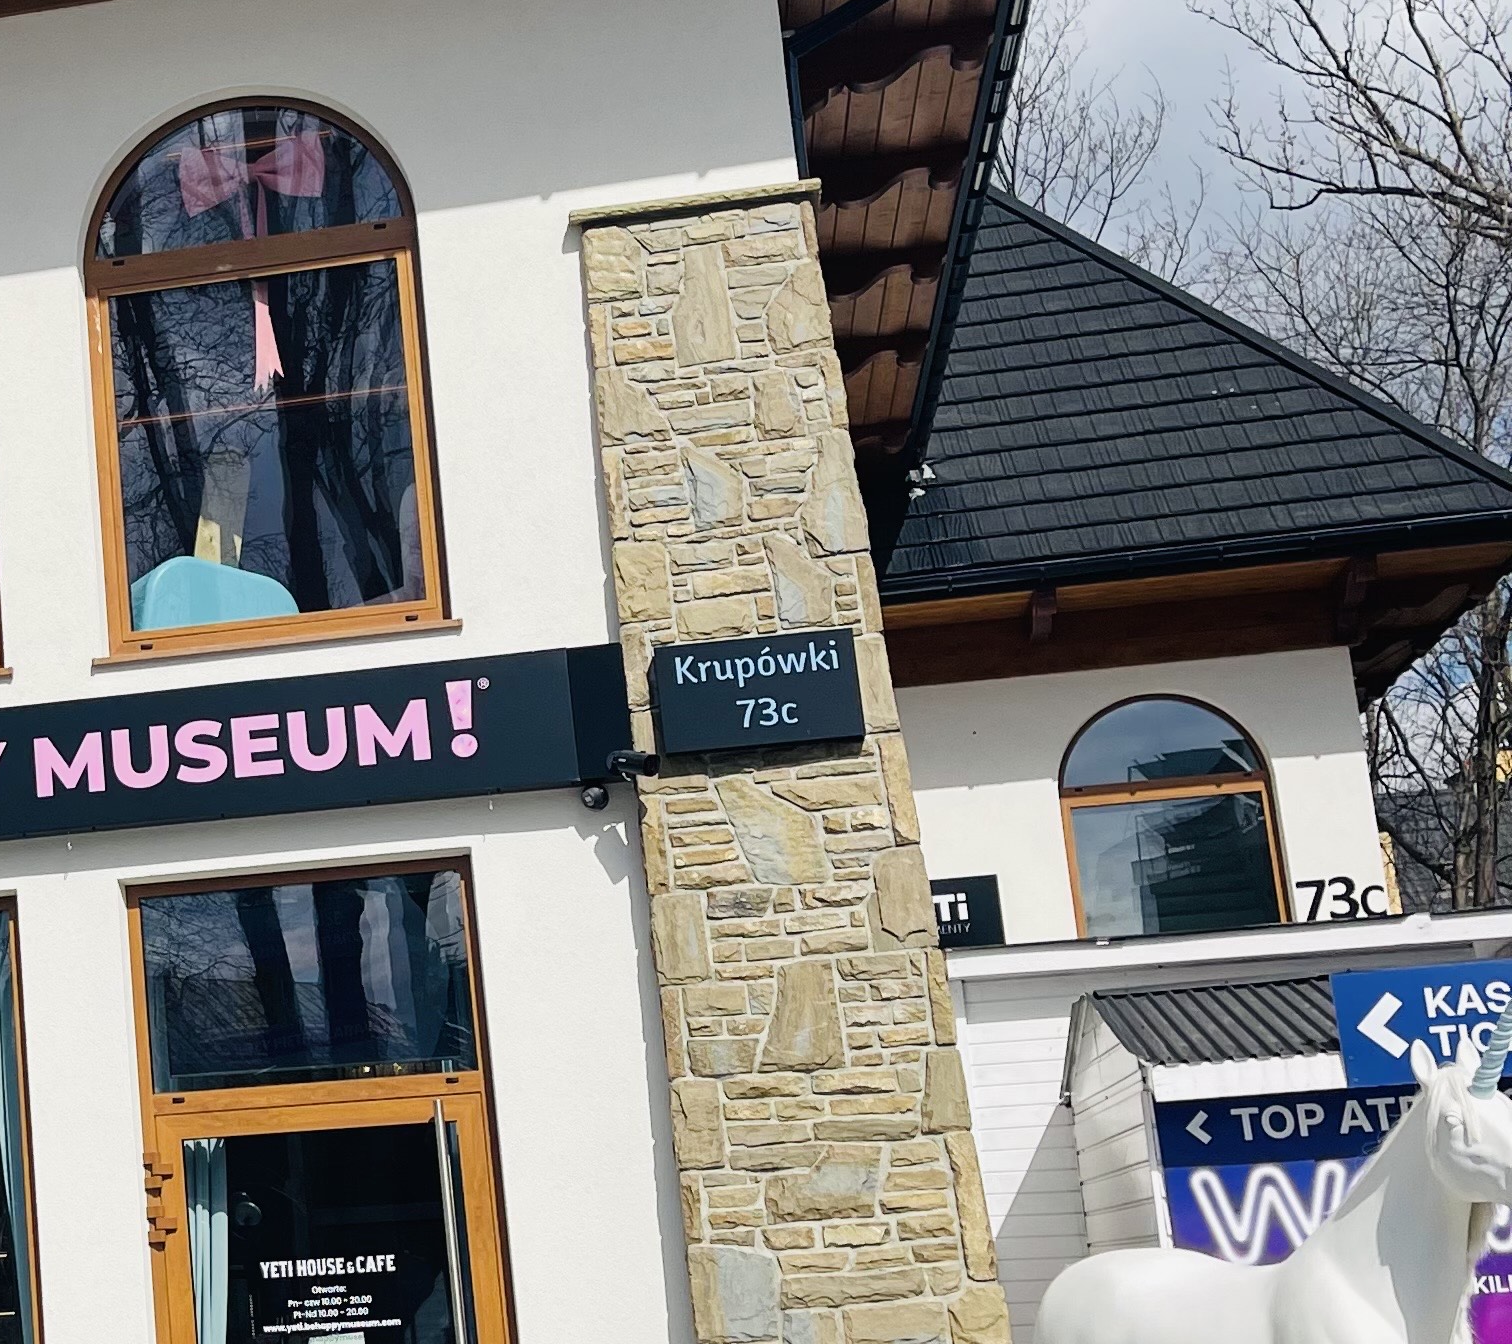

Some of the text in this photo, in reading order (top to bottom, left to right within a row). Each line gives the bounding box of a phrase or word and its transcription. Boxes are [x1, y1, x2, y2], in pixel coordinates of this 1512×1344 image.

[674, 640, 839, 688] Krupówki
[735, 697, 799, 729] 73c
[1295, 875, 1388, 922] 73c
[1230, 1103, 1326, 1141] TOP
[260, 1260, 293, 1278] YETI
[295, 1257, 346, 1277] HOUSE
[355, 1254, 396, 1273] CAFE
[349, 1294, 373, 1305] 20.00
